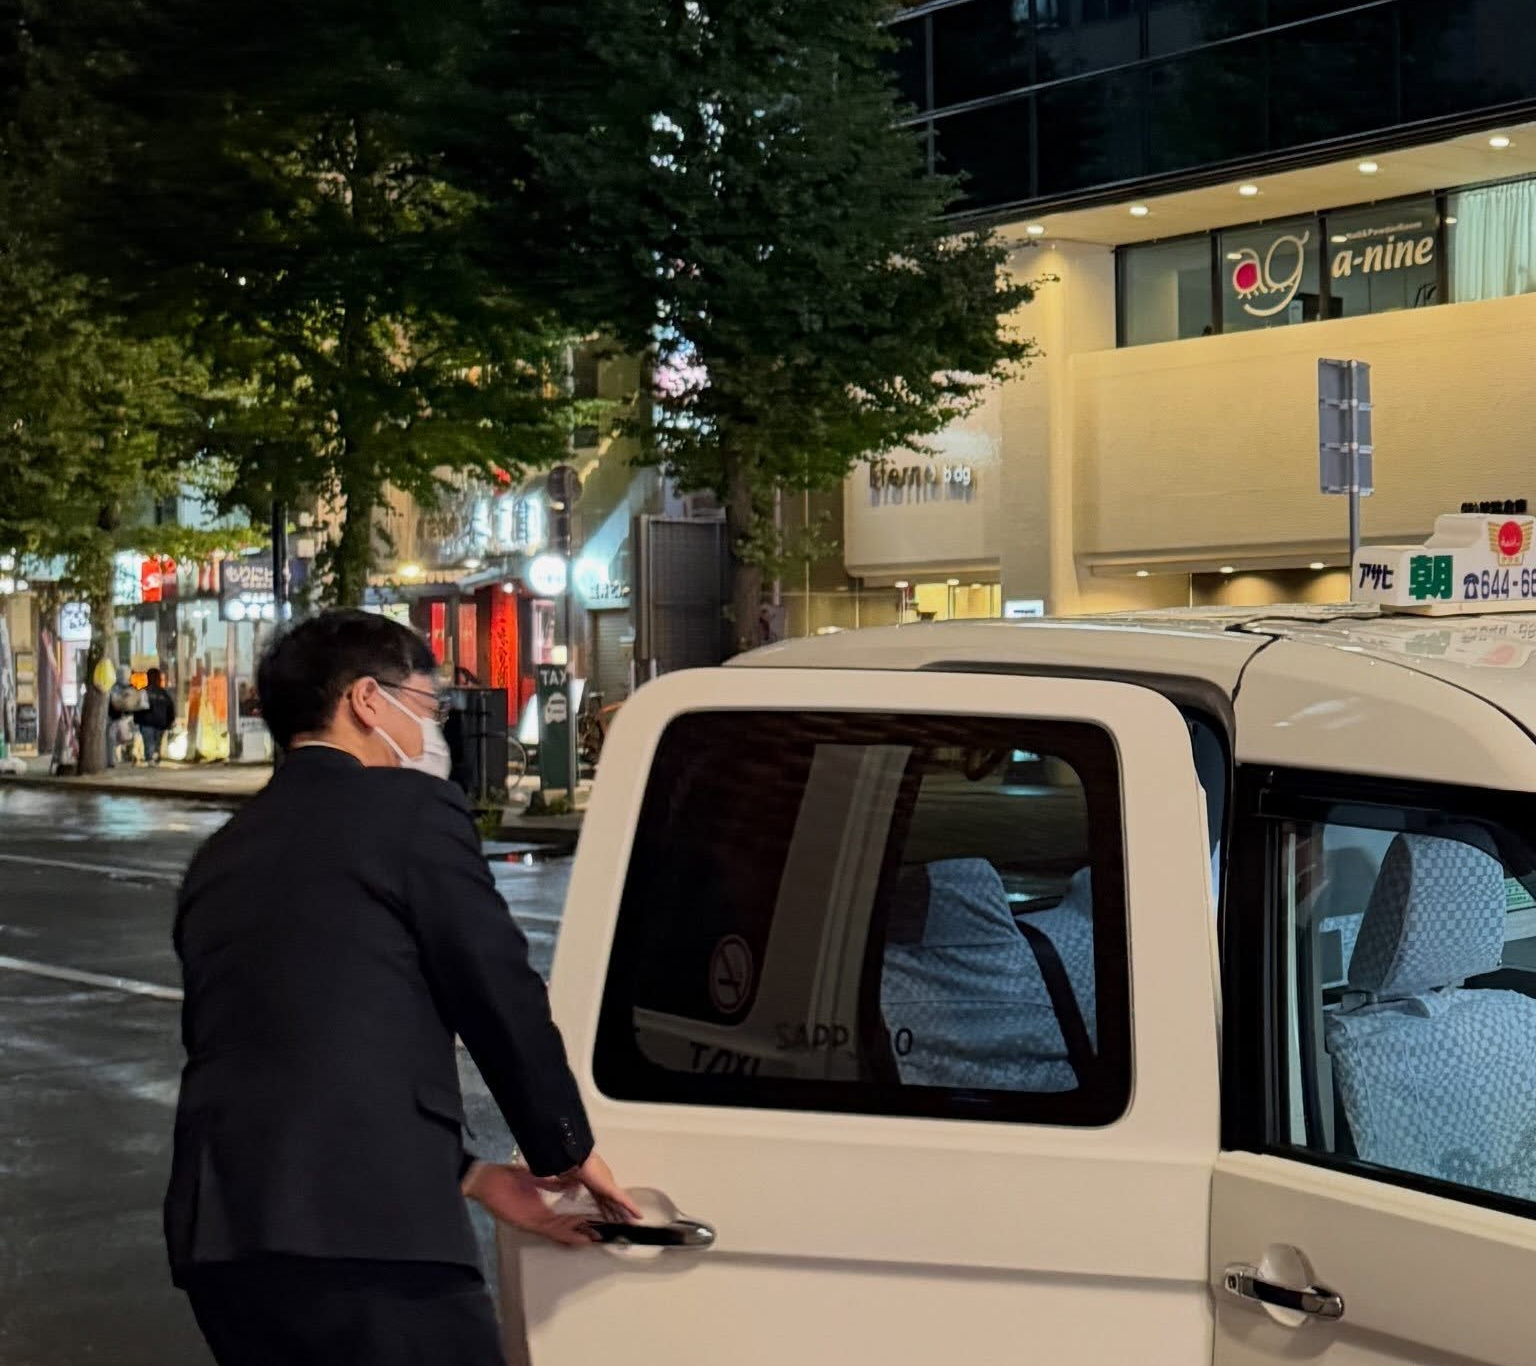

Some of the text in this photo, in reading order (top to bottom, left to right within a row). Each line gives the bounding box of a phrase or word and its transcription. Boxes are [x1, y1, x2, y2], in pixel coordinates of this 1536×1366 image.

[1331, 235, 1434, 278] a-nine
[1359, 563, 1394, 590] アサヒ
[540, 669, 568, 686] TAX
